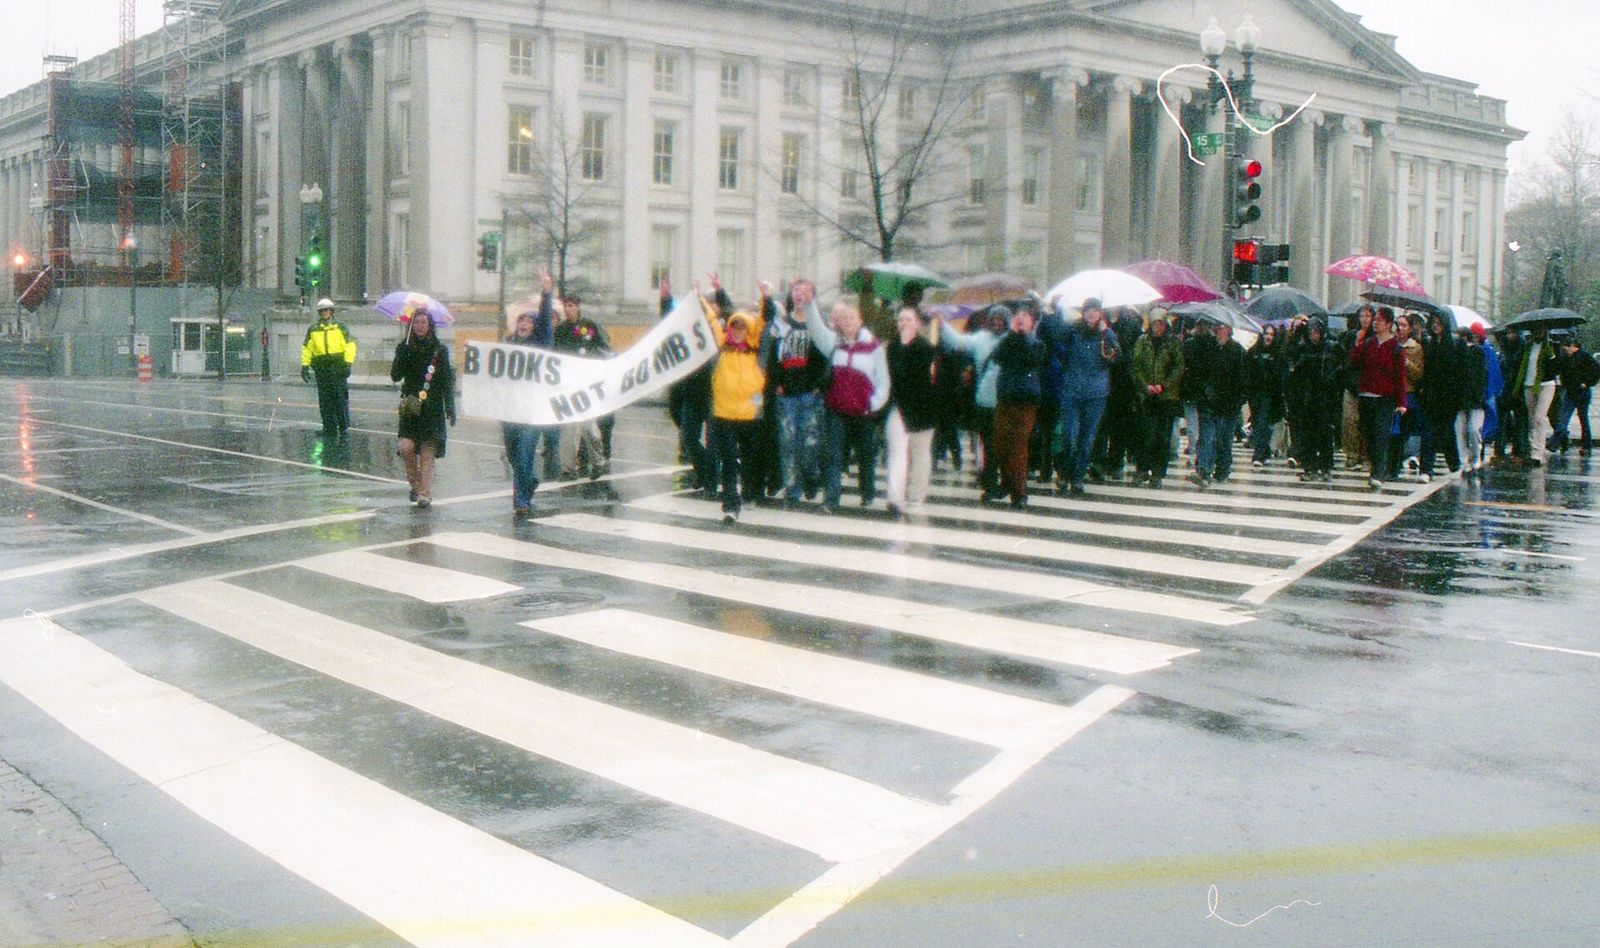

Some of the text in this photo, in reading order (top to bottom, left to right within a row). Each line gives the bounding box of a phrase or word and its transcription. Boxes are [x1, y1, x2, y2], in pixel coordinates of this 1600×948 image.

[1197, 135, 1208, 146] 15
[464, 345, 562, 386] BOOKS
[549, 321, 707, 421] NOT BOMBS
